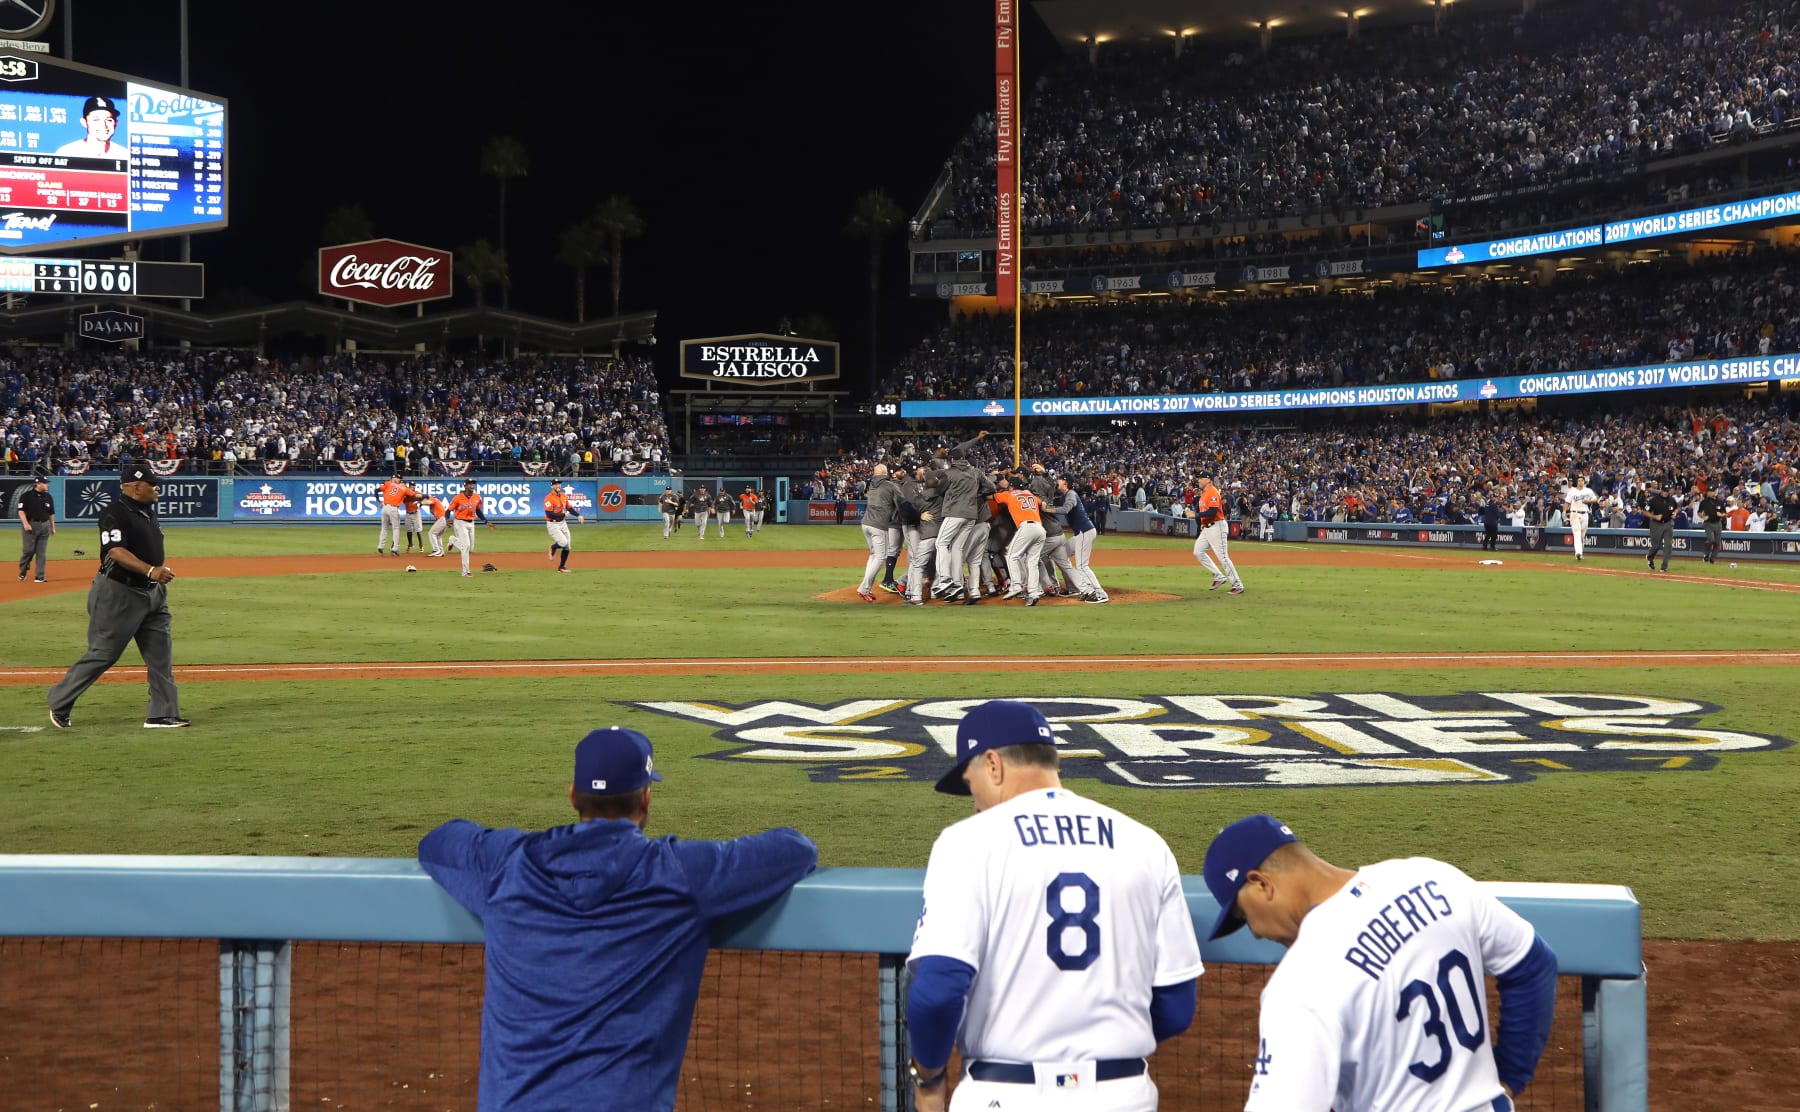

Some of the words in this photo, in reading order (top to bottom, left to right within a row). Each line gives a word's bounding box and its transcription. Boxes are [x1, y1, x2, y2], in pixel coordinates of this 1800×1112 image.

[998, 26, 1012, 48] Fly
[998, 79, 1009, 137] Emirates
[998, 140, 1012, 162] Fly
[13, 155, 36, 164] SPEED
[38, 157, 53, 165] OFF
[54, 158, 69, 166] BAT
[998, 192, 1011, 250] Emirates
[1489, 227, 1601, 257] CONGRATULATIONS
[1605, 223, 1630, 240] 2017
[1632, 216, 1676, 235] WORLD
[1678, 208, 1720, 229] SERIES
[39, 265, 47, 276] 5
[53, 266, 61, 277] 5
[68, 267, 76, 278] 0
[330, 254, 440, 290] Coca-Cola
[998, 253, 1013, 275] Fly
[1335, 262, 1357, 273] 1988
[84, 270, 97, 291] 0
[101, 271, 114, 291] 0
[117, 271, 131, 292] 0
[1188, 274, 1210, 284] 1965
[1262, 268, 1282, 278] 1981
[40, 280, 46, 290] 1
[53, 280, 61, 291] 6
[70, 280, 75, 292] 1
[957, 285, 980, 294] 1955
[1035, 281, 1058, 291] 1959
[1112, 279, 1134, 288] 1963
[84, 318, 139, 334] DASANI
[700, 346, 820, 362] ESTRELLA
[712, 362, 808, 377] JALISCO
[1519, 370, 1635, 394] CONGRATULATIONS
[1637, 367, 1665, 385] 2017
[1667, 365, 1718, 383] WORLD
[1721, 360, 1770, 379] SERIES
[1032, 399, 1160, 413] CONGRATULATIONS
[1163, 398, 1189, 410] 2017
[1192, 396, 1238, 409] WORLD
[1240, 394, 1281, 408] SERIES
[1283, 391, 1356, 406] CHAMPIONS
[1358, 388, 1415, 403] HOUSTON
[1416, 384, 1459, 400] ASTROS
[875, 404, 897, 415] 8:58
[157, 484, 207, 497] URITY
[306, 483, 337, 495] 2017
[447, 483, 531, 495] CHMPIONS
[390, 487, 398, 497] 9
[240, 499, 292, 508] CHAMPIONS
[440, 496, 531, 516] AROS
[600, 489, 622, 507] 76
[1017, 496, 1037, 510] 30
[809, 508, 830, 517] Bank
[843, 508, 867, 517] meric
[1634, 538, 1653, 548] WOR
[632, 692, 1704, 726] WORLD
[727, 716, 1772, 760] SERIES
[1014, 814, 1115, 849] GEREN
[1046, 872, 1100, 971] 8
[1345, 880, 1453, 981] ROBERTS
[1396, 949, 1485, 1084] 30
